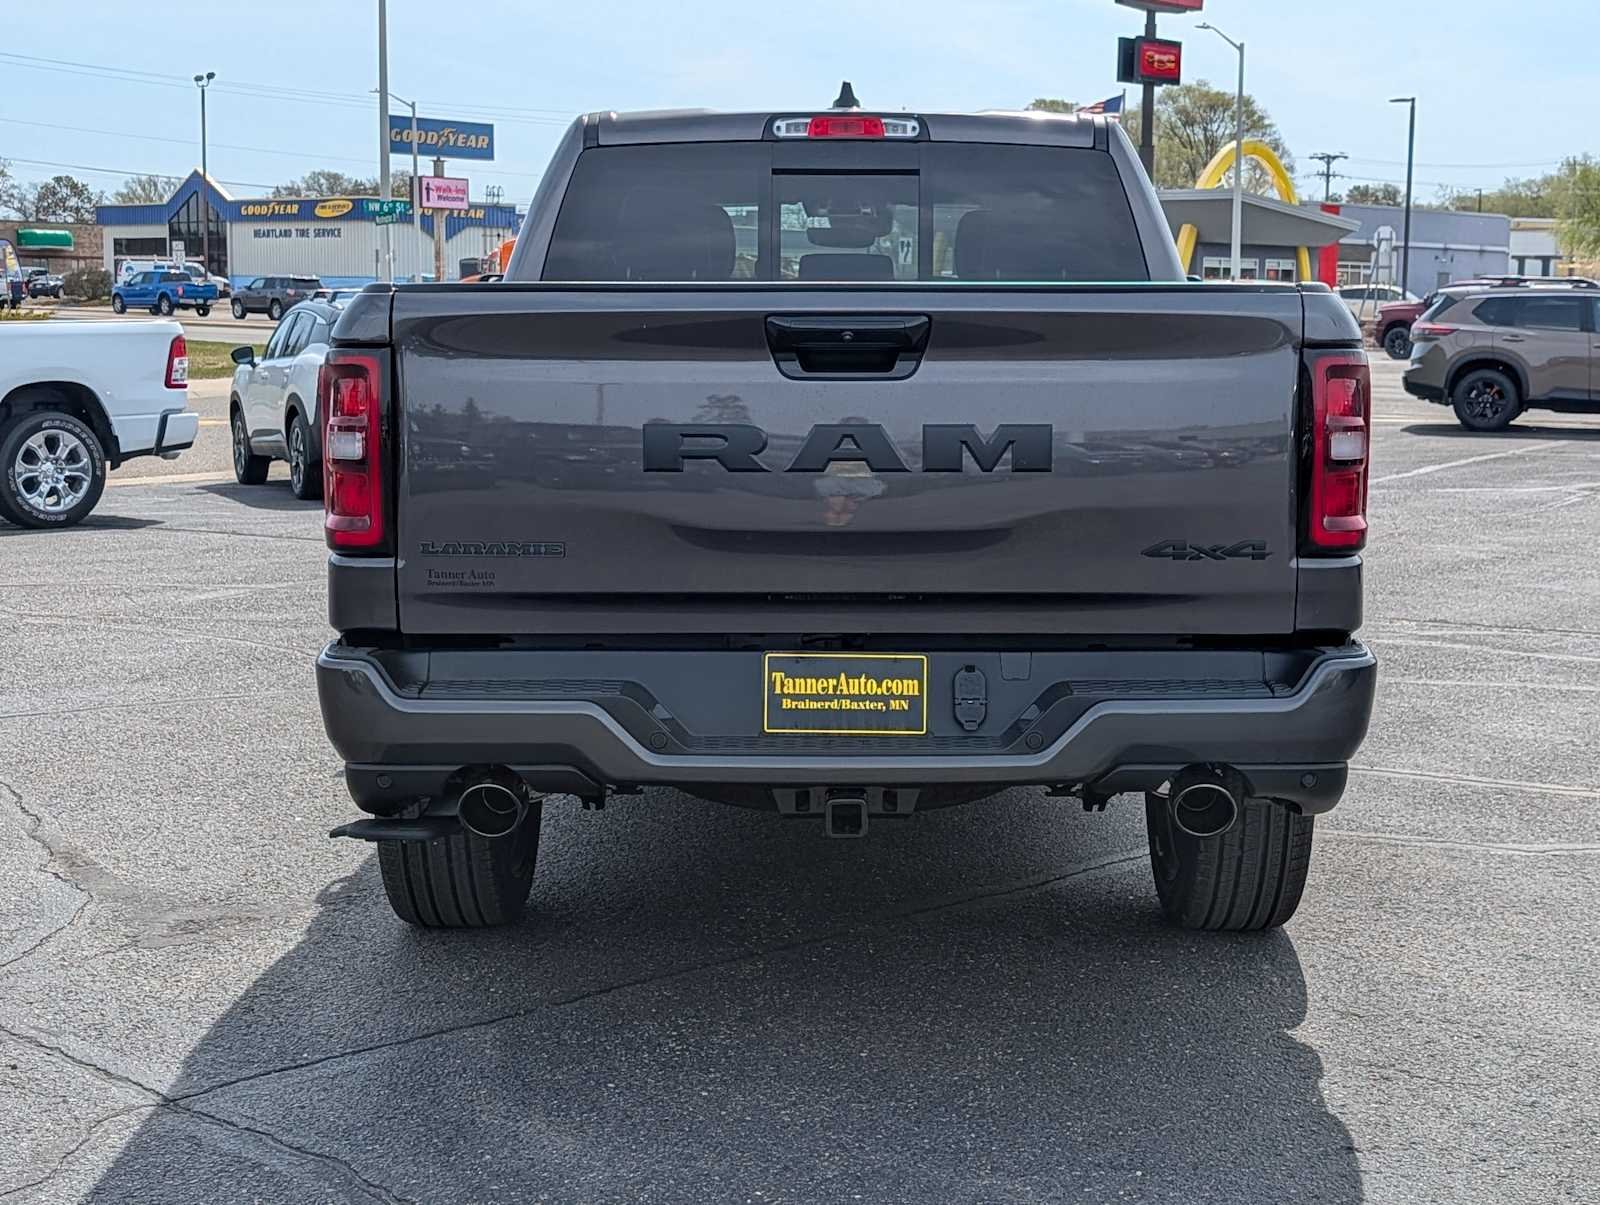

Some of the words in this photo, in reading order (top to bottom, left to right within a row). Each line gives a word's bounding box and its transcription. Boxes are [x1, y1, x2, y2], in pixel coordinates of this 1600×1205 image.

[391, 127, 489, 149] GOODYEAR
[241, 202, 299, 216] GOODYEAR
[253, 228, 293, 239] HEARTLAND
[295, 228, 310, 239] TIRE
[313, 227, 342, 239] SERVICE
[642, 423, 1053, 473] RAM
[420, 541, 566, 558] LARAMIE
[426, 568, 465, 580] Tanner
[468, 568, 496, 580] Auto
[771, 671, 920, 696] TannerAuto.com
[781, 698, 887, 713] Brainerd/Baxter,
[889, 699, 909, 711] MN
